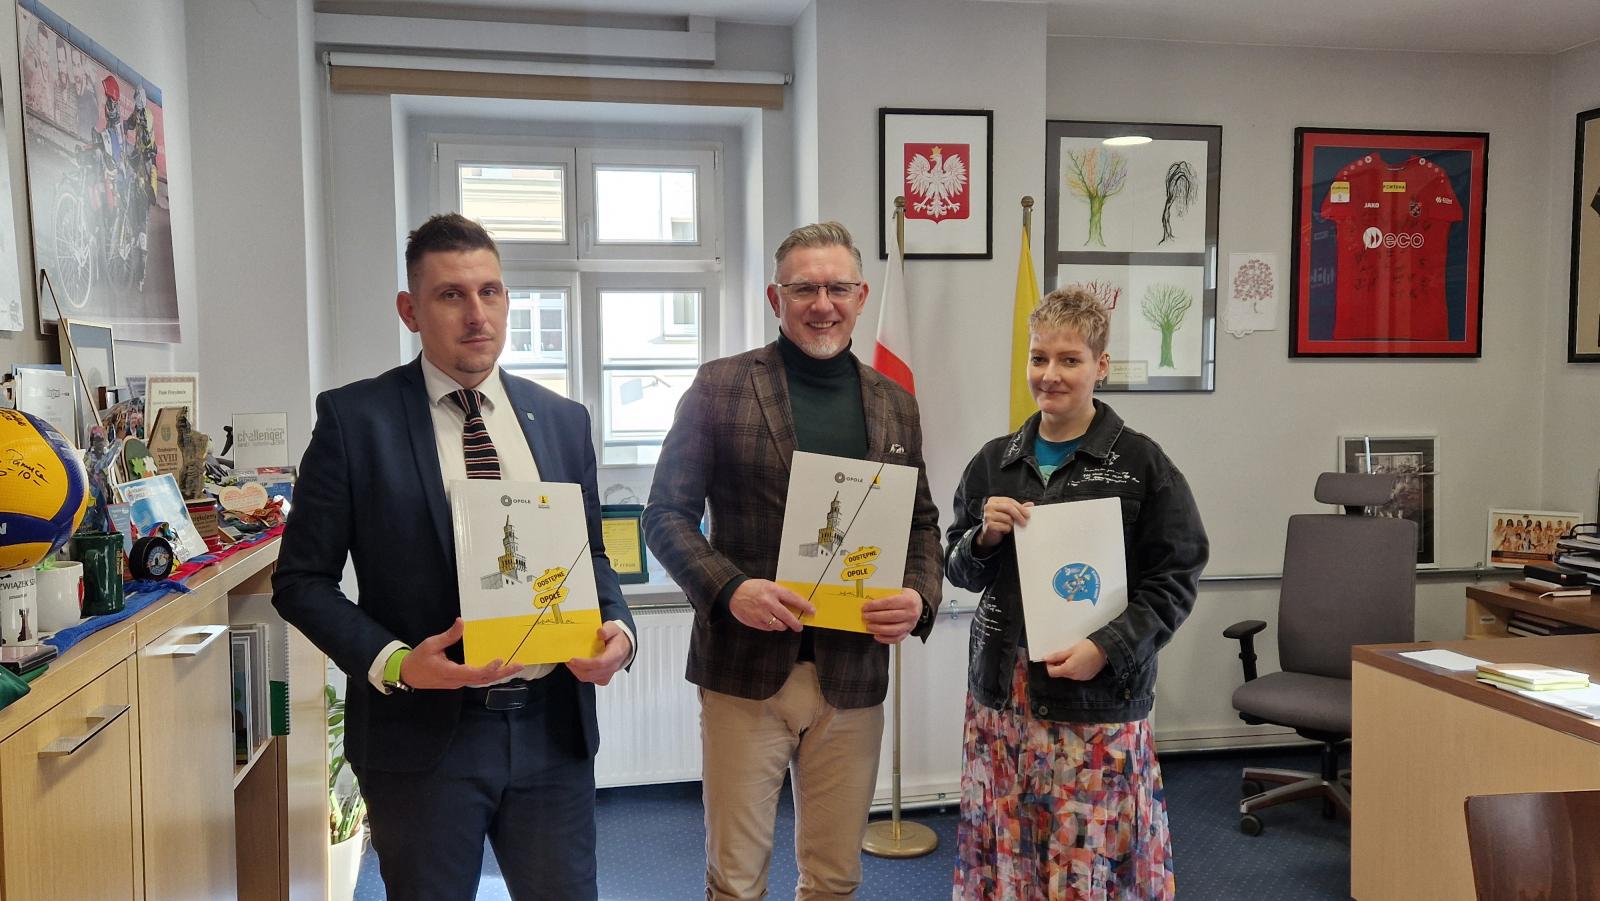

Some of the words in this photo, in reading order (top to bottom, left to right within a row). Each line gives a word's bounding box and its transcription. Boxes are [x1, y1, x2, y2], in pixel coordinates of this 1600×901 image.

[237, 429, 285, 445] challenger
[158, 453, 178, 463] XVIII
[847, 568, 868, 578] OPOLE
[540, 591, 562, 604] OPOLE
